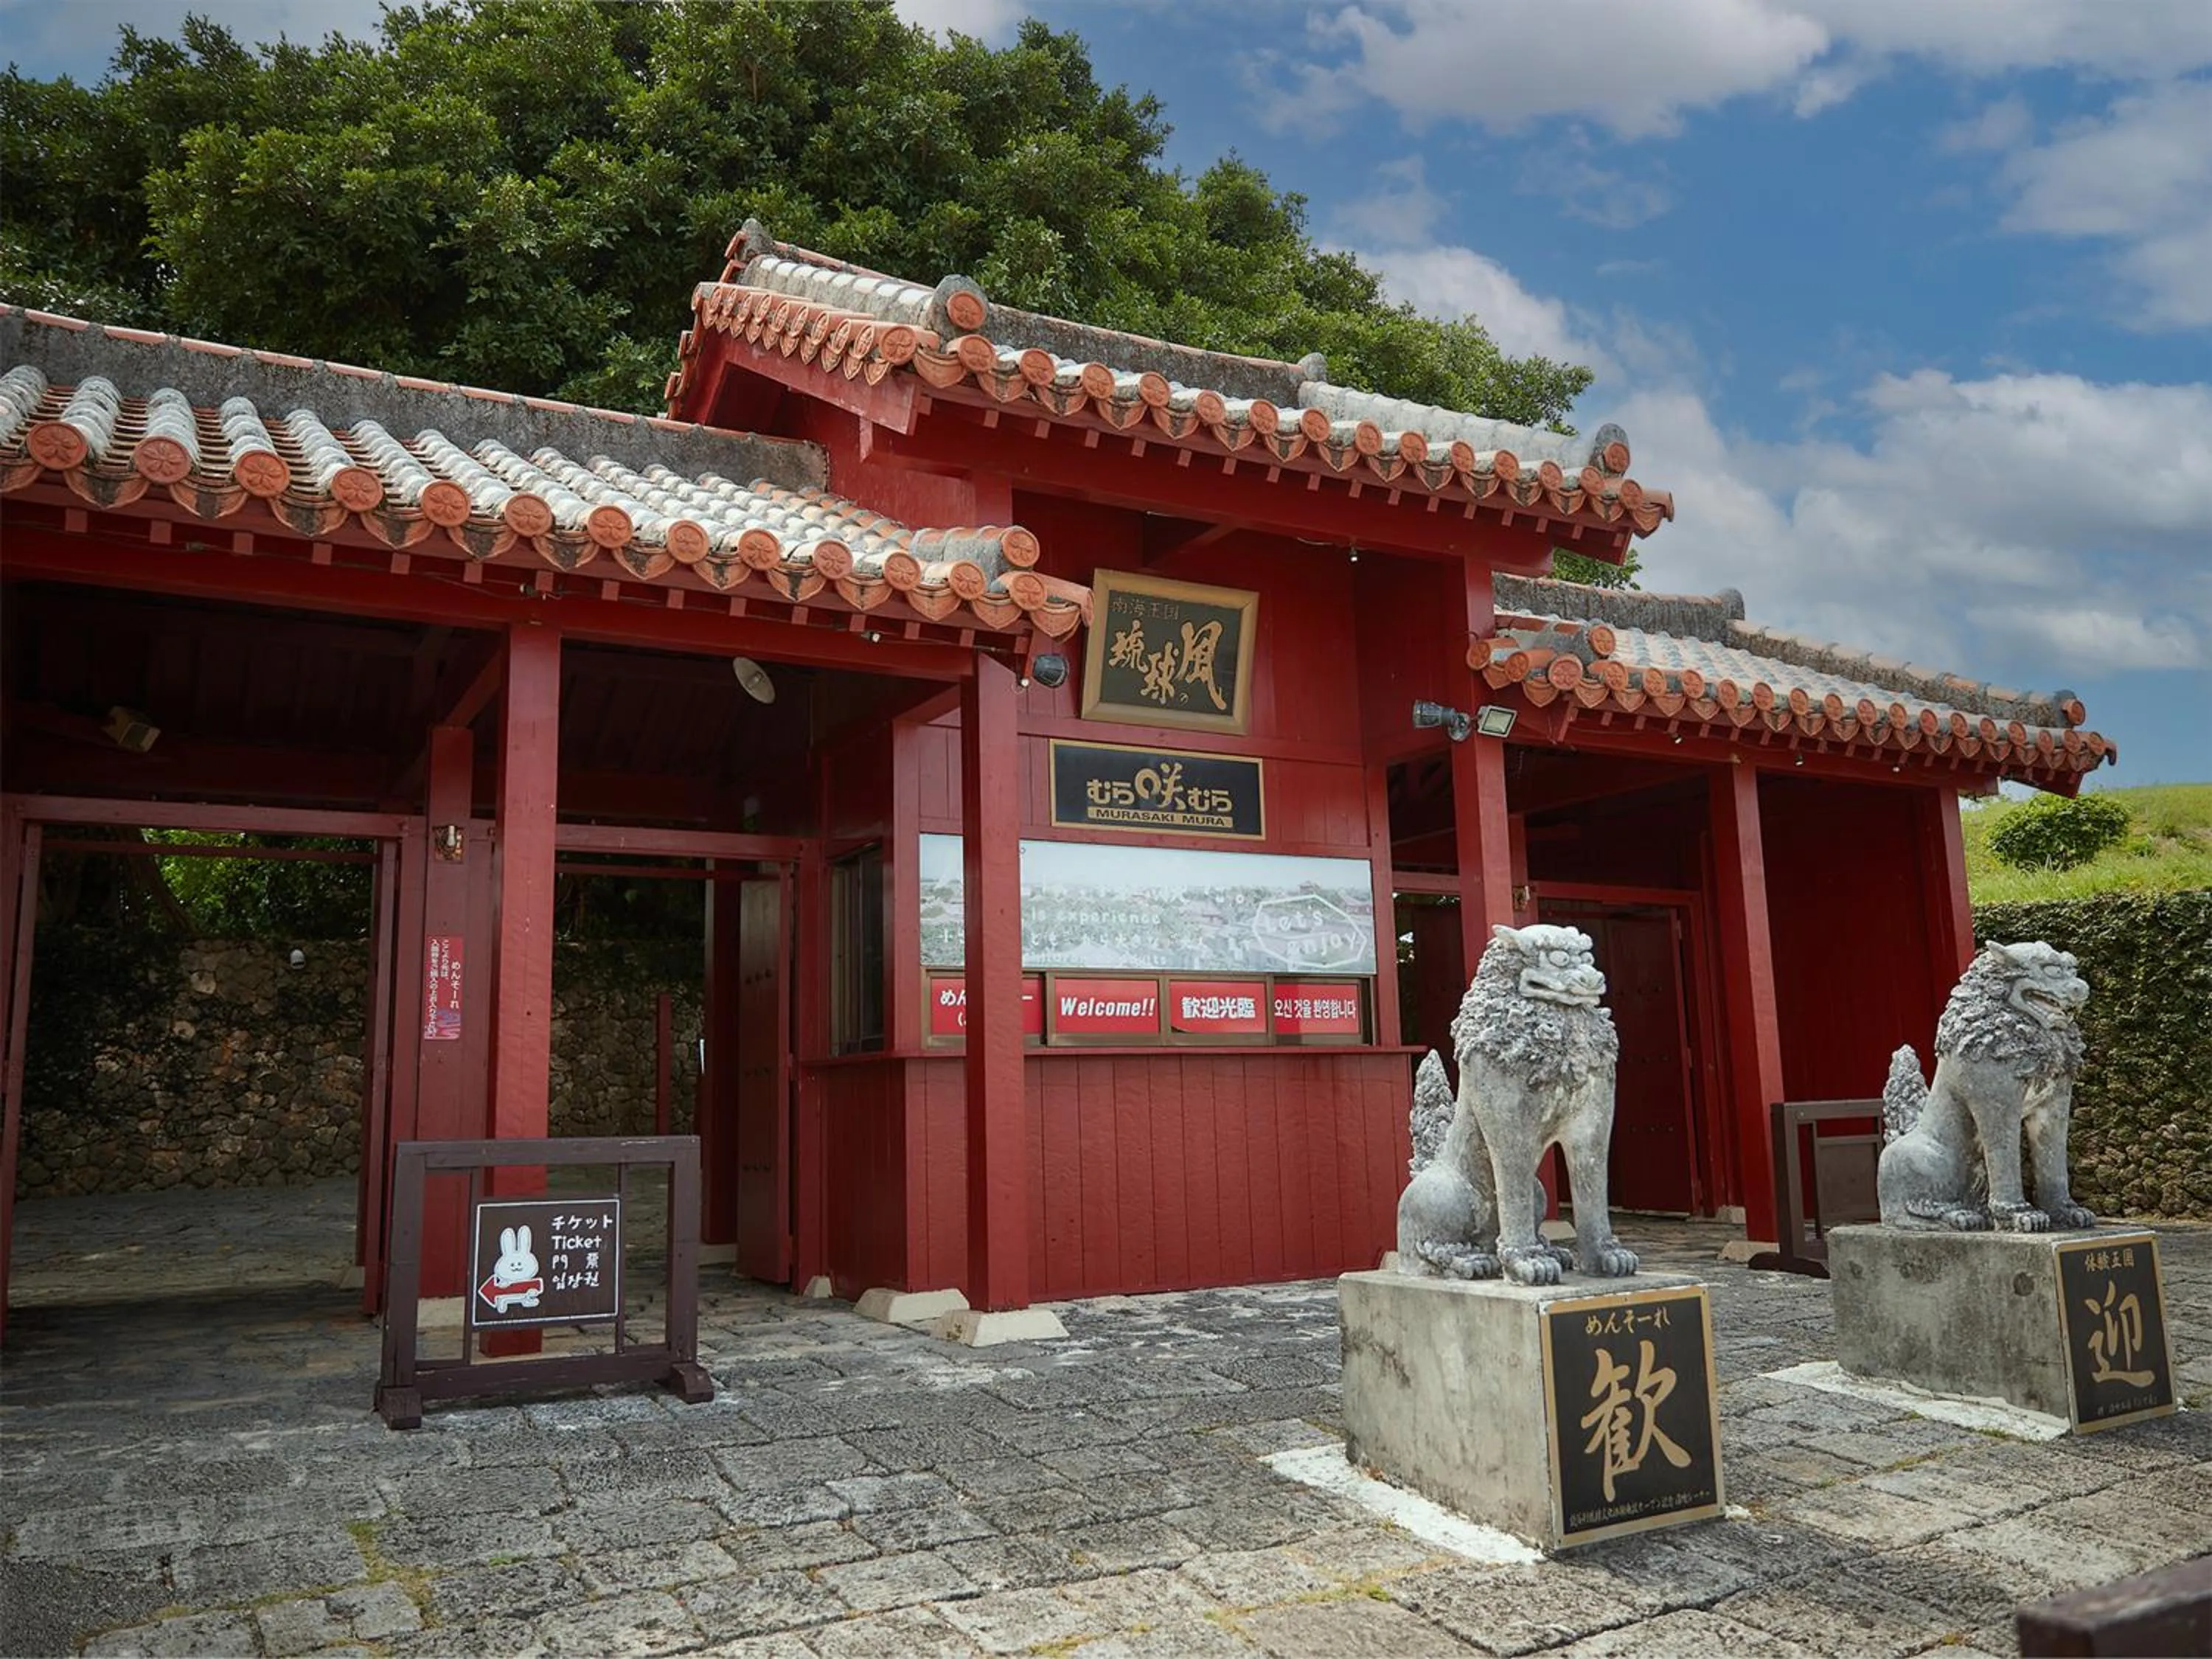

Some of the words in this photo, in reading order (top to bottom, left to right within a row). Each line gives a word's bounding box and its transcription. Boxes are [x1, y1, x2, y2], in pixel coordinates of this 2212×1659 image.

[1087, 762, 1232, 812] むら咲むら
[1096, 809, 1174, 822] MURASAKI
[1182, 815, 1225, 827] MURA
[1057, 909, 1161, 925] experience
[450, 961, 461, 1009] めんそーれ
[1060, 997, 1155, 1017] Welcome!!
[1274, 999, 1292, 1018] 오신
[1293, 999, 1312, 1018] 것을
[1313, 999, 1357, 1019] 환영합니다
[552, 1214, 613, 1231] チケット
[552, 1235, 602, 1250] Ticket
[552, 1271, 599, 1290] 입장권
[1585, 1306, 1670, 1336] めんそーれ
[2084, 1279, 2155, 1388] 迎
